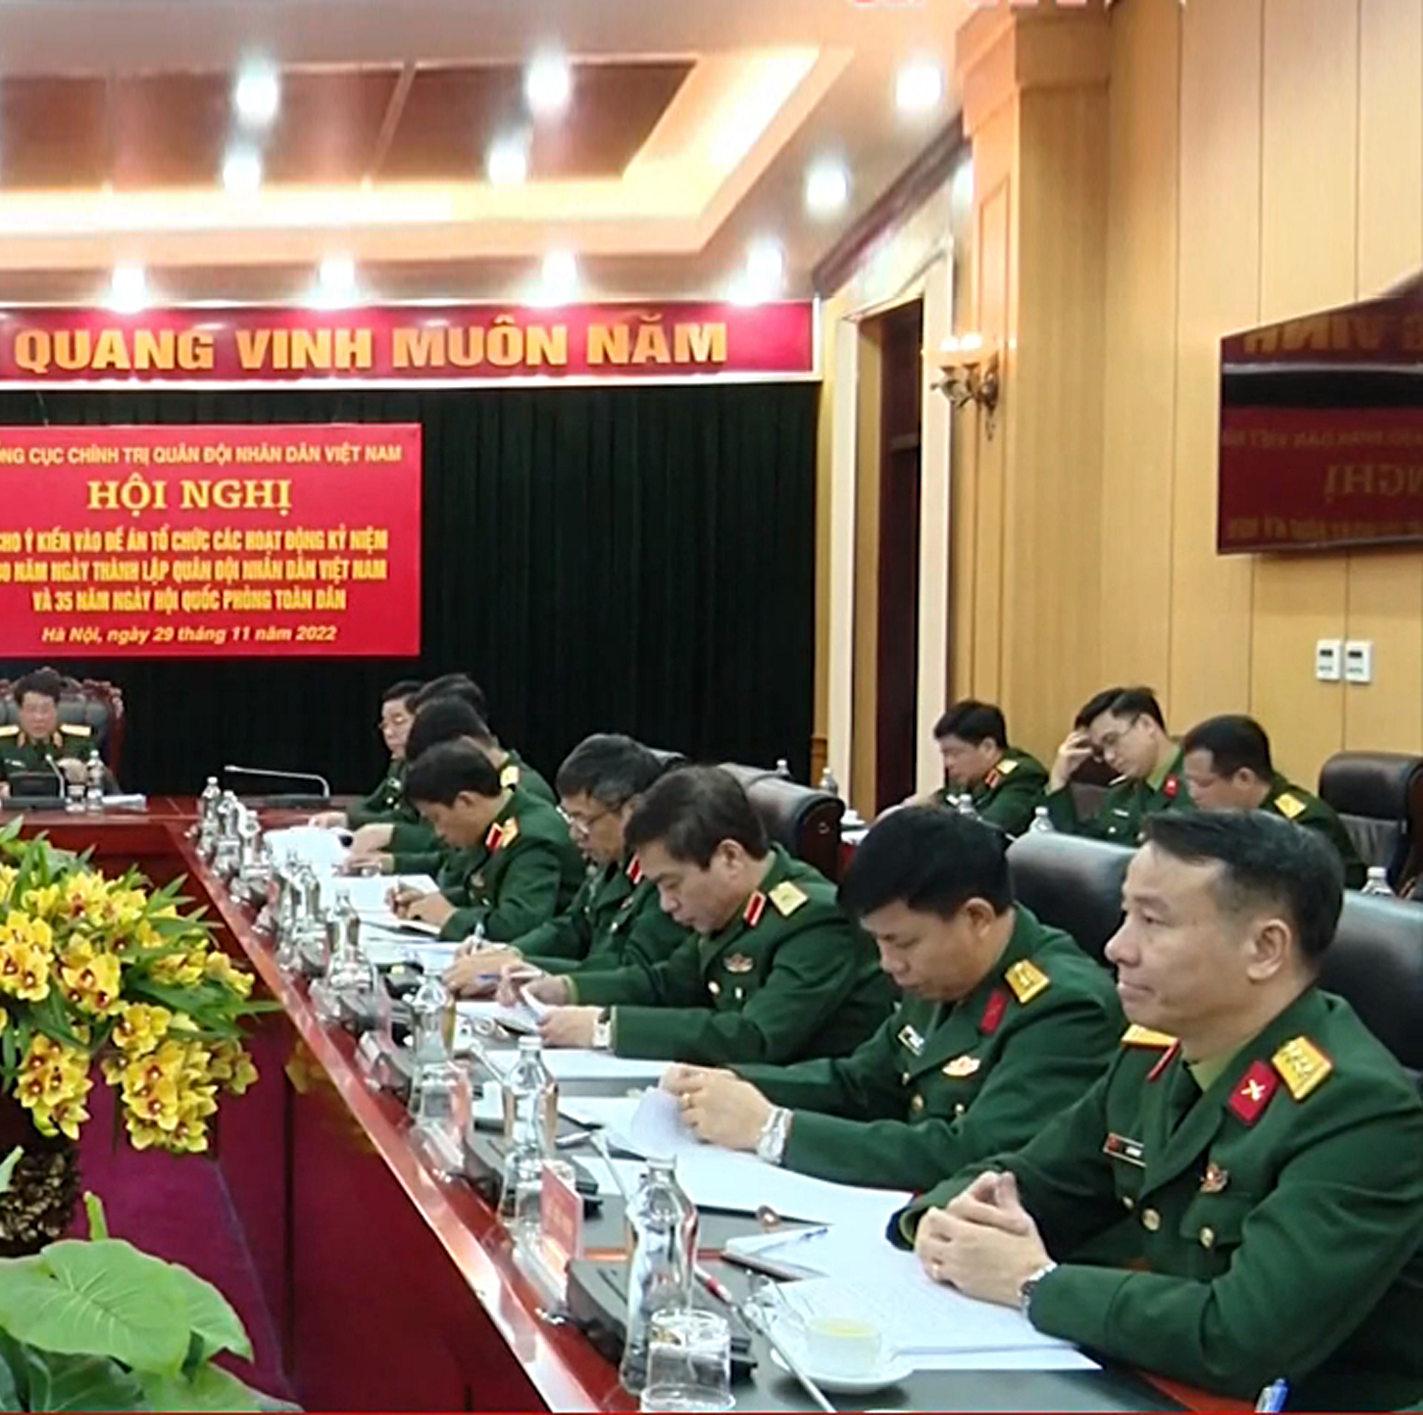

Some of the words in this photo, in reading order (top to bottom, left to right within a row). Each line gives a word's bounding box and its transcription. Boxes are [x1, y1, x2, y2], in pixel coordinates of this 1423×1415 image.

[15, 329, 215, 372] QUANG
[235, 329, 372, 371] VINH
[393, 315, 567, 369] MUÔN
[588, 315, 727, 366] NĂM
[29, 447, 64, 467] CỤC
[67, 443, 119, 465] CHÍNH
[123, 447, 150, 466] TRỊ
[153, 443, 200, 465] QUÂN
[203, 443, 232, 467] ĐỘI
[235, 442, 282, 463] NHÂN
[285, 442, 321, 463] DÂN
[324, 441, 361, 466] VIỆT
[364, 445, 403, 463] NAM
[87, 472, 167, 517] HỘI
[180, 478, 293, 517] NGHỊ
[36, 525, 71, 552] KIẾN
[73, 526, 102, 552] VÀO
[126, 526, 148, 552] ÁN
[151, 523, 170, 552] TỔ
[171, 526, 211, 552] CHỨC
[213, 526, 242, 551] CÁC
[245, 529, 282, 555] HOẠT
[284, 526, 325, 555] ĐỘNG
[349, 525, 389, 555] NIỆM
[14, 558, 48, 582] NĂM
[51, 556, 90, 582] NGÀY
[92, 556, 140, 582] THÀNH
[142, 556, 170, 585] LẬP
[172, 556, 212, 583] QUÂN
[214, 555, 240, 585] ĐỘI
[242, 555, 283, 580] NHÂN
[285, 555, 317, 580] DÂN
[319, 555, 350, 585] VIỆT
[352, 559, 387, 580] NAM
[33, 586, 52, 611] VÀ
[55, 591, 74, 611] 35
[76, 587, 110, 611] NĂM
[112, 586, 151, 611] NGÀY
[154, 586, 179, 615] HỘI
[181, 584, 220, 613] QUỐC
[223, 585, 272, 610] PHÒNG
[275, 585, 313, 610] TOÀN
[316, 585, 347, 610] DÂN
[41, 626, 66, 643] Hà
[69, 626, 102, 645] Nội,
[107, 626, 150, 645] ngày
[152, 626, 175, 643] 29
[177, 625, 227, 645] tháng
[232, 625, 251, 641] 11
[255, 625, 293, 641] năm
[295, 624, 337, 641] 2022
